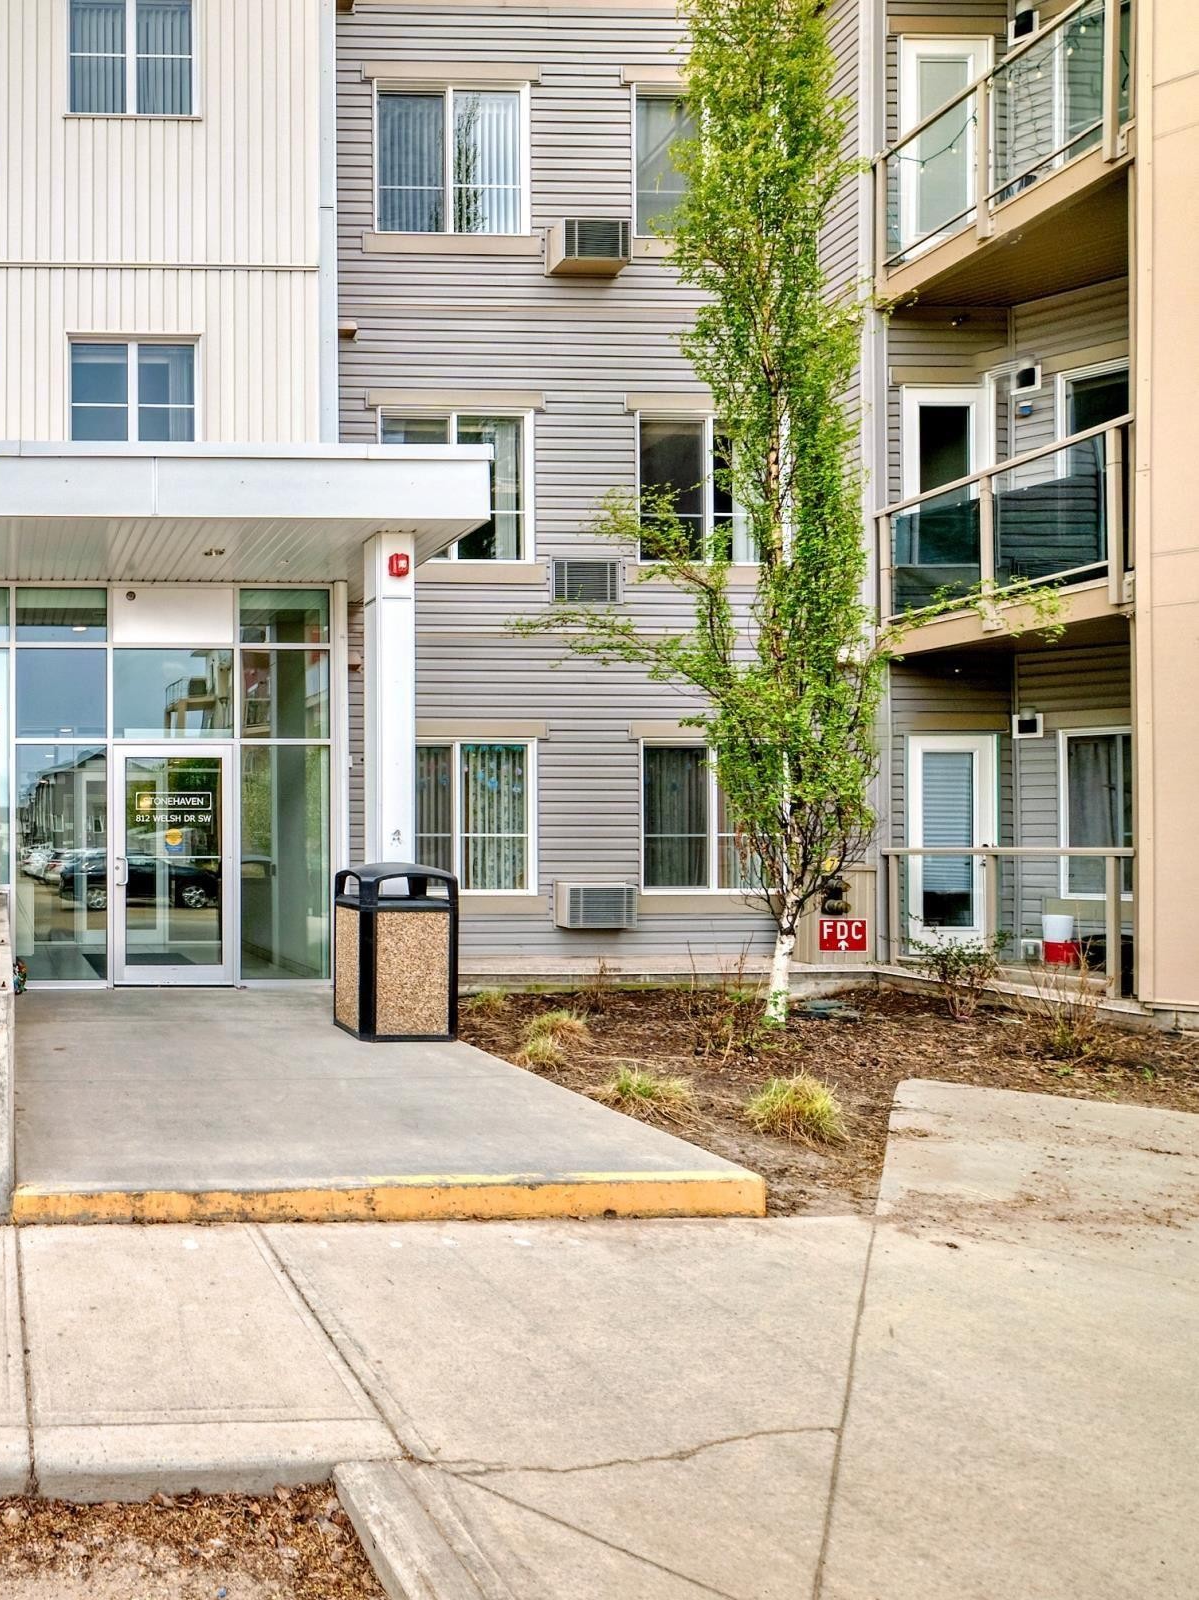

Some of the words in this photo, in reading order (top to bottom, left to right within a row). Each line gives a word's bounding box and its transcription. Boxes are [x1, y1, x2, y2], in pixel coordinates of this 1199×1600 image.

[142, 797, 204, 806] STONEHAVEN
[135, 814, 150, 822] 812
[152, 814, 181, 822] WELSH
[184, 814, 196, 822] DR
[198, 814, 212, 822] SW
[823, 921, 862, 940] FDC
